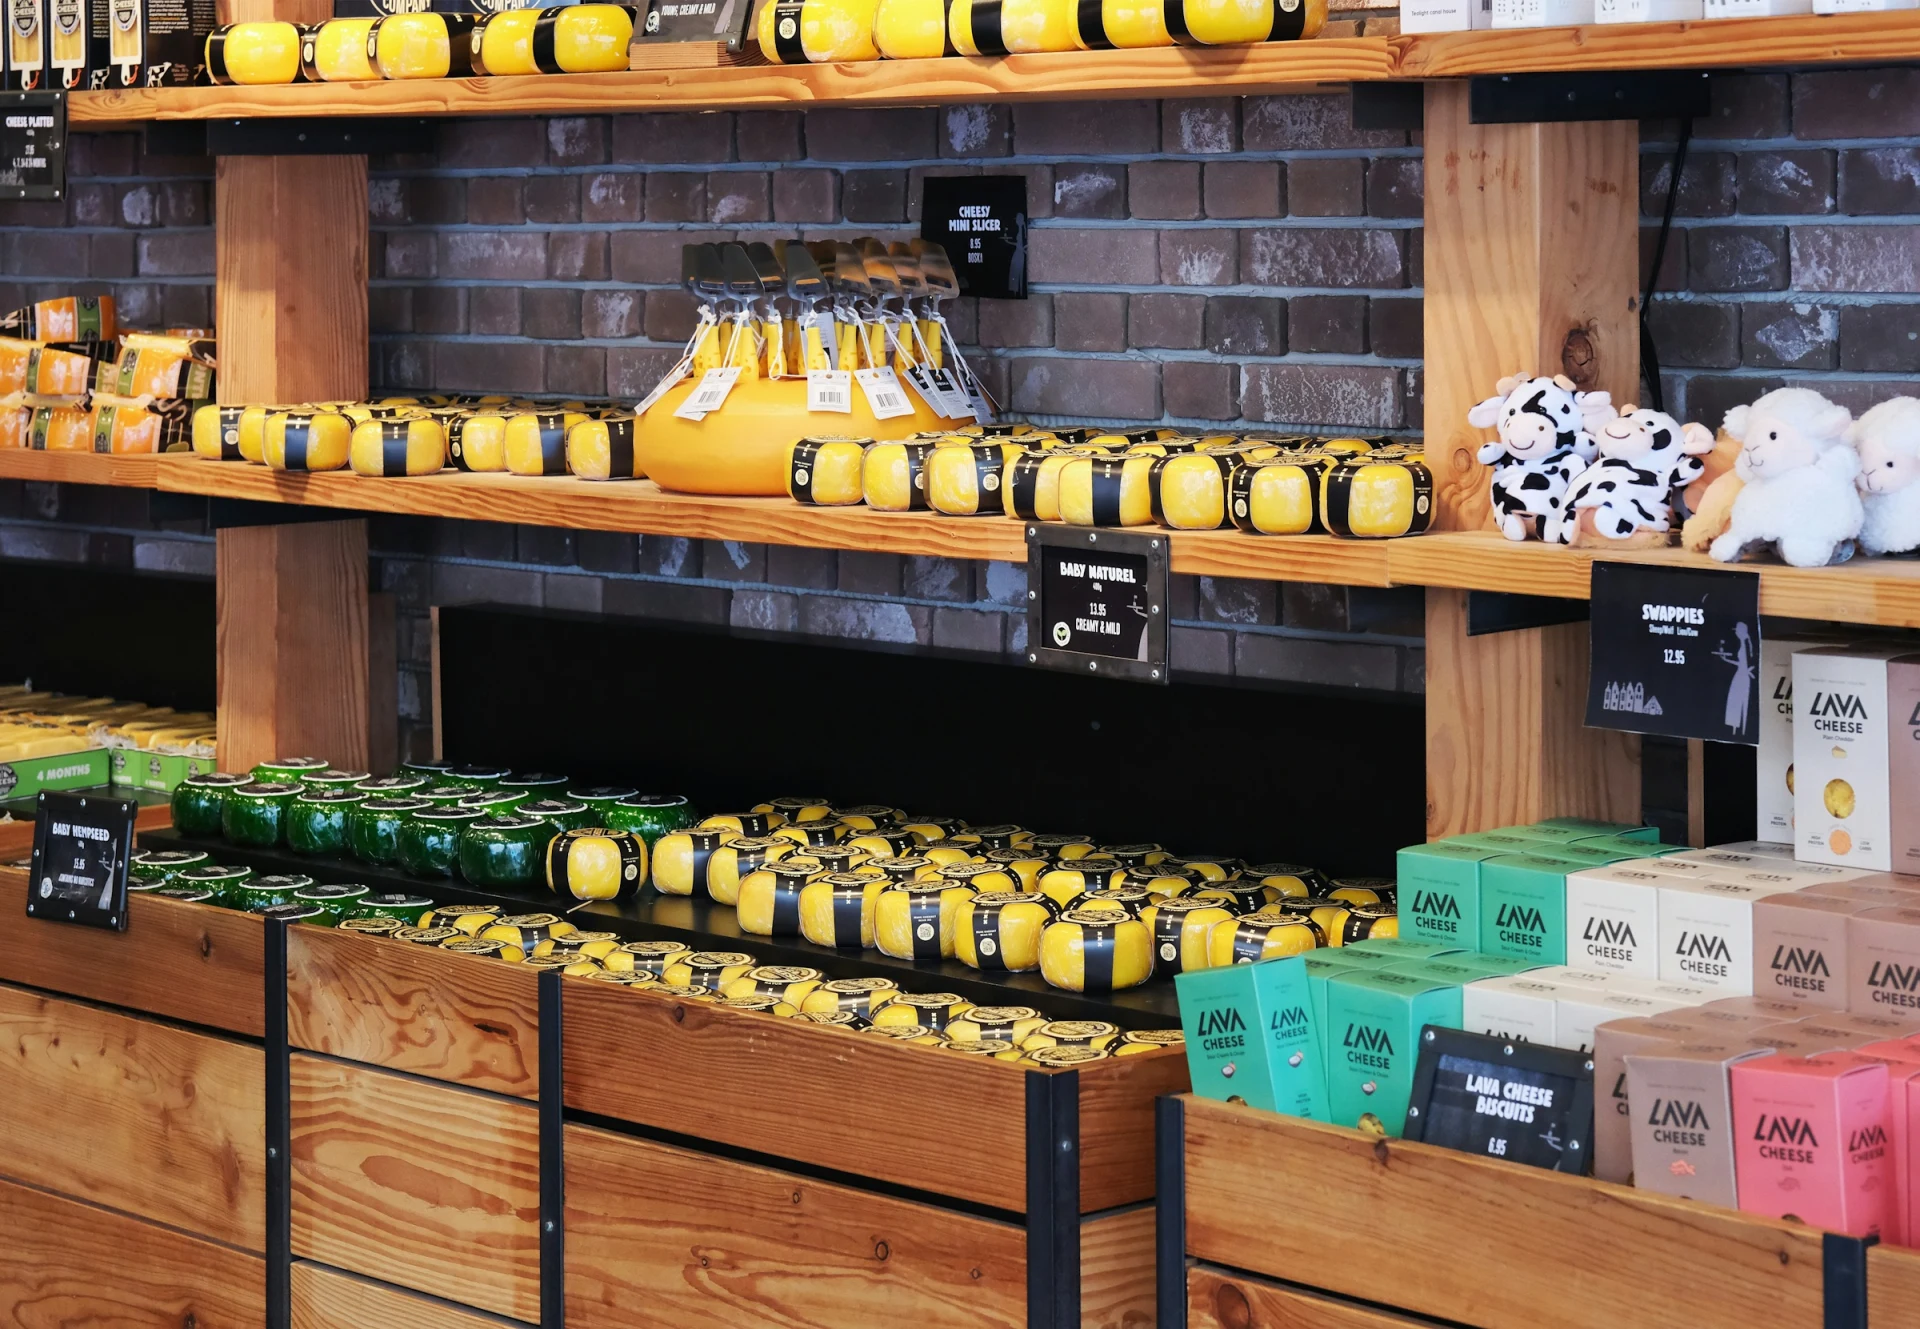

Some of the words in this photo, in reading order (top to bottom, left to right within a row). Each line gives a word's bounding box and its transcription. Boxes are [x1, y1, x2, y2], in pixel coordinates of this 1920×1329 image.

[14, 7, 35, 16] CHEESE
[57, 5, 78, 13] CHEESE
[114, 0, 135, 8] CHEESE
[661, 5, 679, 17] YOUNG,
[679, 4, 698, 15] CREAMY
[704, 3, 716, 14] MILD
[6, 116, 28, 127] CHEESE
[28, 116, 54, 127] PLATTER
[959, 205, 990, 218] CHEESY
[949, 219, 970, 231] MINI
[972, 219, 1001, 231] SLICER
[970, 238, 981, 249] 8.95
[968, 252, 983, 263] BOSKA
[1060, 562, 1086, 579] BABY
[1088, 565, 1136, 583] NATUREL
[1089, 602, 1106, 616] 13.95
[1642, 604, 1704, 625] SWAPPIES
[1076, 617, 1099, 632] CREAMY
[1099, 621, 1105, 634] &
[1106, 621, 1120, 636] MILD
[1664, 649, 1685, 664] 12.95
[1810, 692, 1868, 719] LAVA
[1814, 719, 1863, 734] CHEESE
[37, 770, 44, 781] 4
[47, 763, 91, 781] MONTHS
[53, 822, 71, 836] BABY
[72, 825, 110, 841] HEMPSEED
[1412, 890, 1461, 919] LAVA
[1415, 916, 1457, 933] CHEESE
[1496, 903, 1546, 934] LAVA
[1500, 930, 1542, 947] CHEESE
[1583, 916, 1637, 947] LAVA
[1587, 944, 1633, 962] CHEESE
[1676, 931, 1732, 962] LAVA
[1680, 959, 1727, 977] CHEESE
[1771, 945, 1830, 977] LAVA
[1775, 973, 1825, 992] CHEESE
[1198, 1008, 1246, 1036] LAVA
[1271, 1005, 1308, 1030] LAVA
[1275, 1026, 1308, 1041] CHEESE
[1344, 1023, 1394, 1055] LAVA
[1203, 1035, 1245, 1051] CHEESE
[1347, 1051, 1390, 1069] CHEESE
[1465, 1074, 1500, 1097] LAVA
[1503, 1082, 1554, 1107] CHEESE
[1475, 1095, 1535, 1123] BISCUITS
[1648, 1098, 1710, 1130] LAVA
[1654, 1129, 1706, 1146] CHEESE
[1754, 1114, 1818, 1147] LAVA
[1849, 1124, 1887, 1152] LAVA
[1488, 1137, 1507, 1155] 6.95
[1759, 1145, 1814, 1163] CHEESE
[1852, 1147, 1884, 1164] CHEESE
